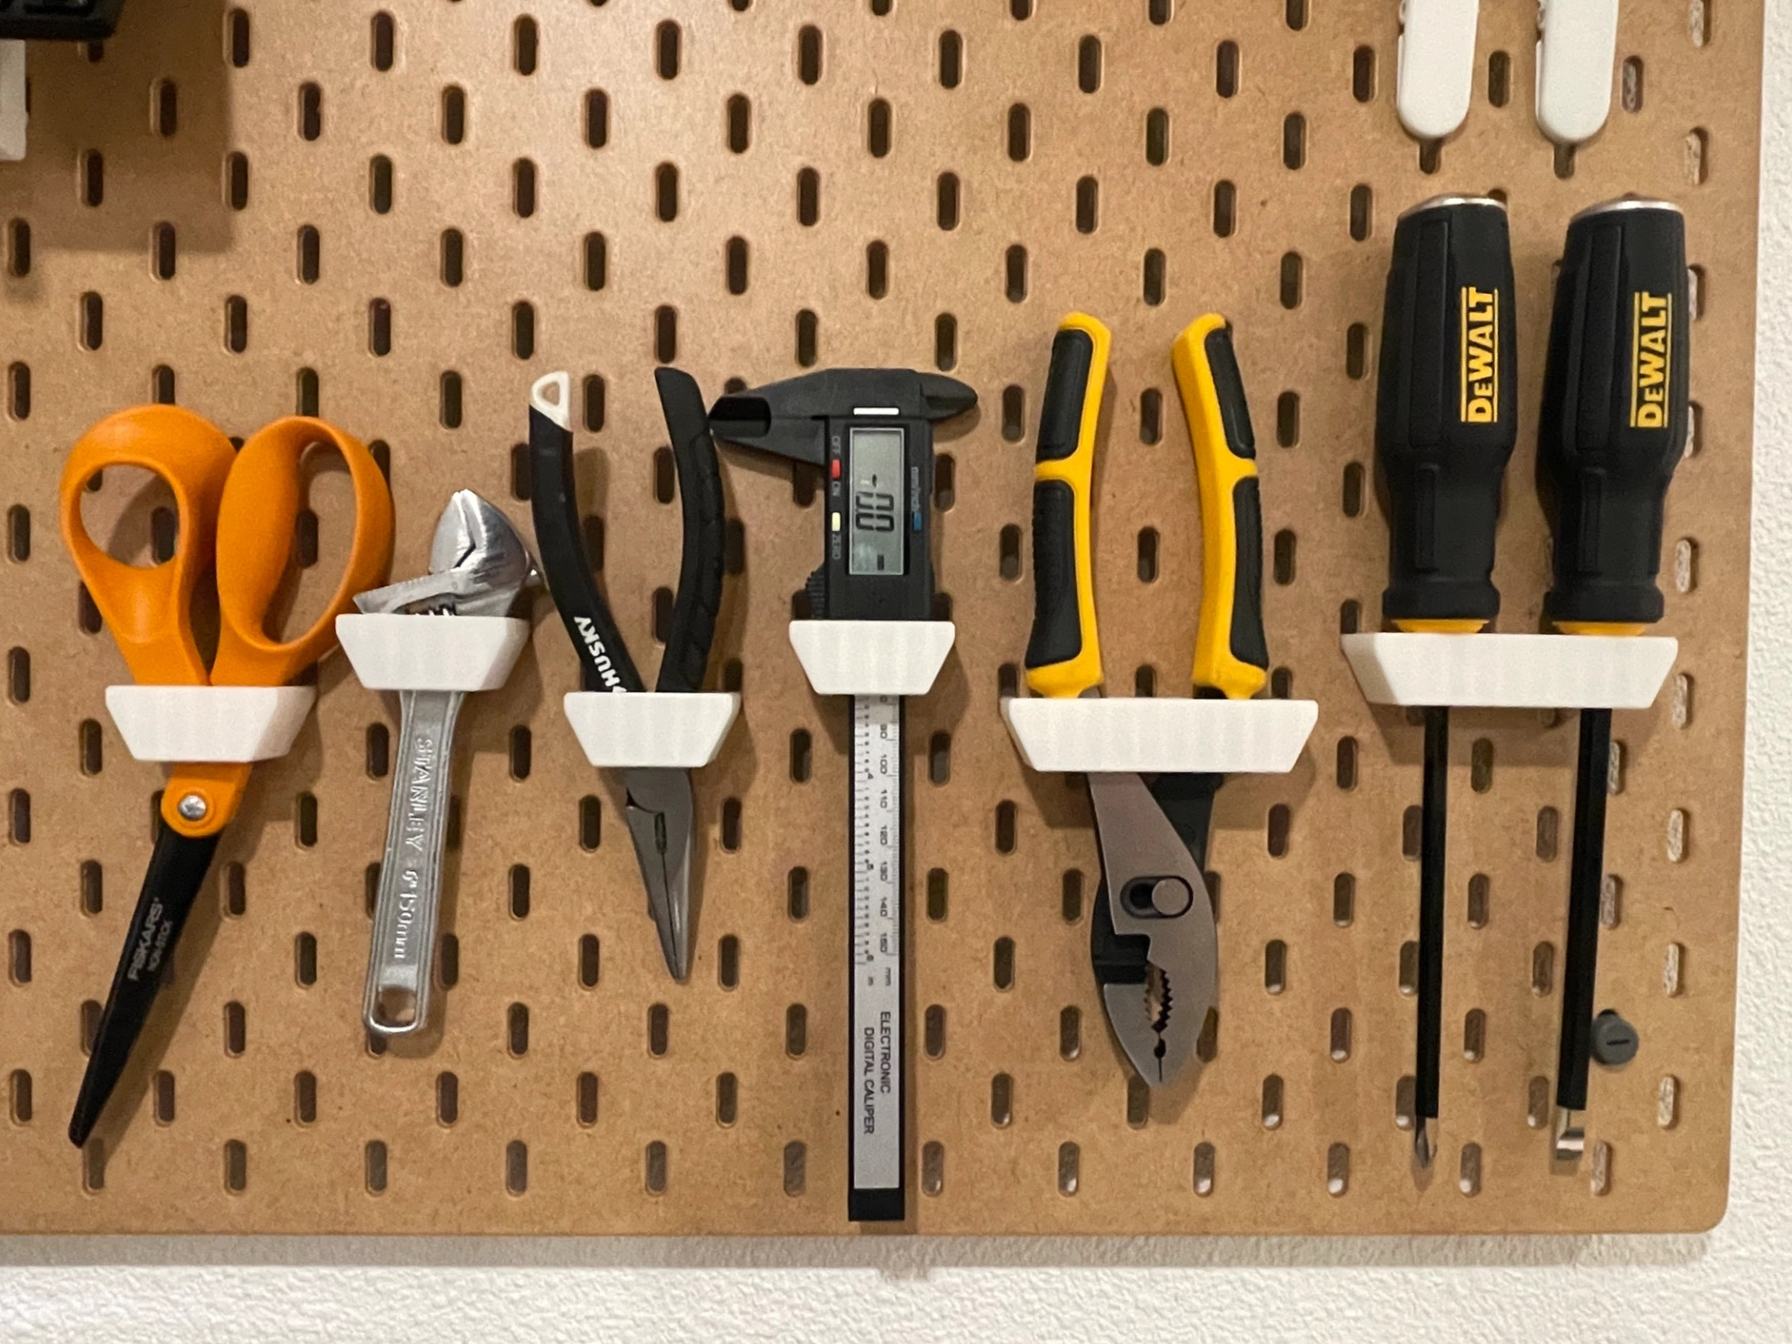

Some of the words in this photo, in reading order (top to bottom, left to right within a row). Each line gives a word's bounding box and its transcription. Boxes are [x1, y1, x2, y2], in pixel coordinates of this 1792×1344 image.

[573, 616, 621, 687] HUSKY
[880, 754, 888, 774] 100
[867, 772, 875, 780] 4
[405, 738, 433, 851] STANLEY
[880, 789, 888, 808] 110
[880, 825, 888, 845] 120
[880, 861, 888, 881] 130
[880, 897, 888, 917] 140
[880, 933, 888, 953] 150
[864, 1027, 875, 1076] DIGITAL
[880, 1011, 891, 1094] ELECTRONIC
[864, 1079, 875, 1135] CALIPER
